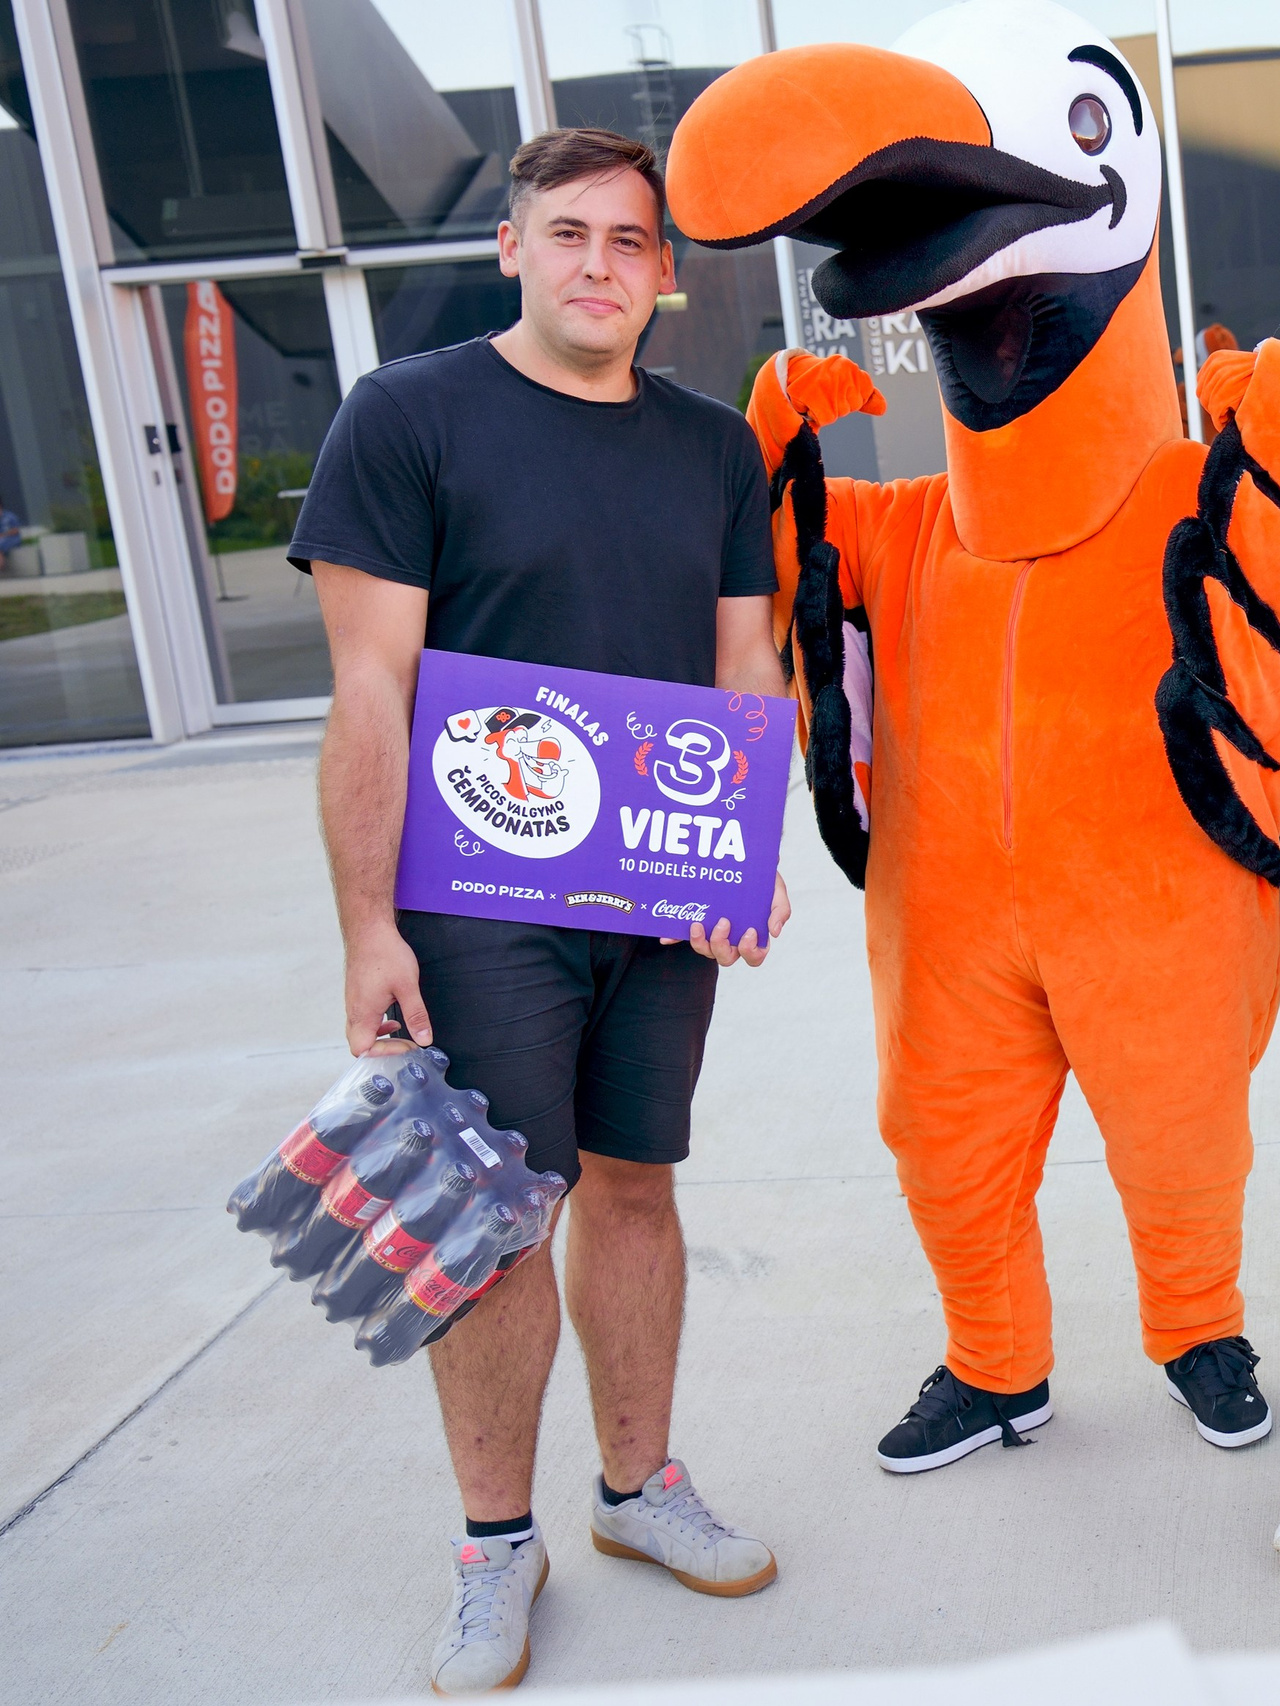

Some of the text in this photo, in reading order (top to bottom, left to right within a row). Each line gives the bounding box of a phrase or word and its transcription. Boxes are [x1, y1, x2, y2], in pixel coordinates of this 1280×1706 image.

[868, 317, 885, 376] VERSLO
[884, 339, 929, 375] KI
[196, 280, 236, 495] DODO PIZZA
[535, 686, 609, 746] FINALAS
[654, 718, 731, 806] 3
[447, 765, 571, 837] ČEMPIONATAS
[476, 774, 565, 818] PICOS VALGYMO
[619, 806, 746, 862] VIETA
[451, 880, 496, 895] DODO
[498, 885, 545, 900] PIZZA
[618, 858, 743, 884] 10 DIDELĖS PICOS
